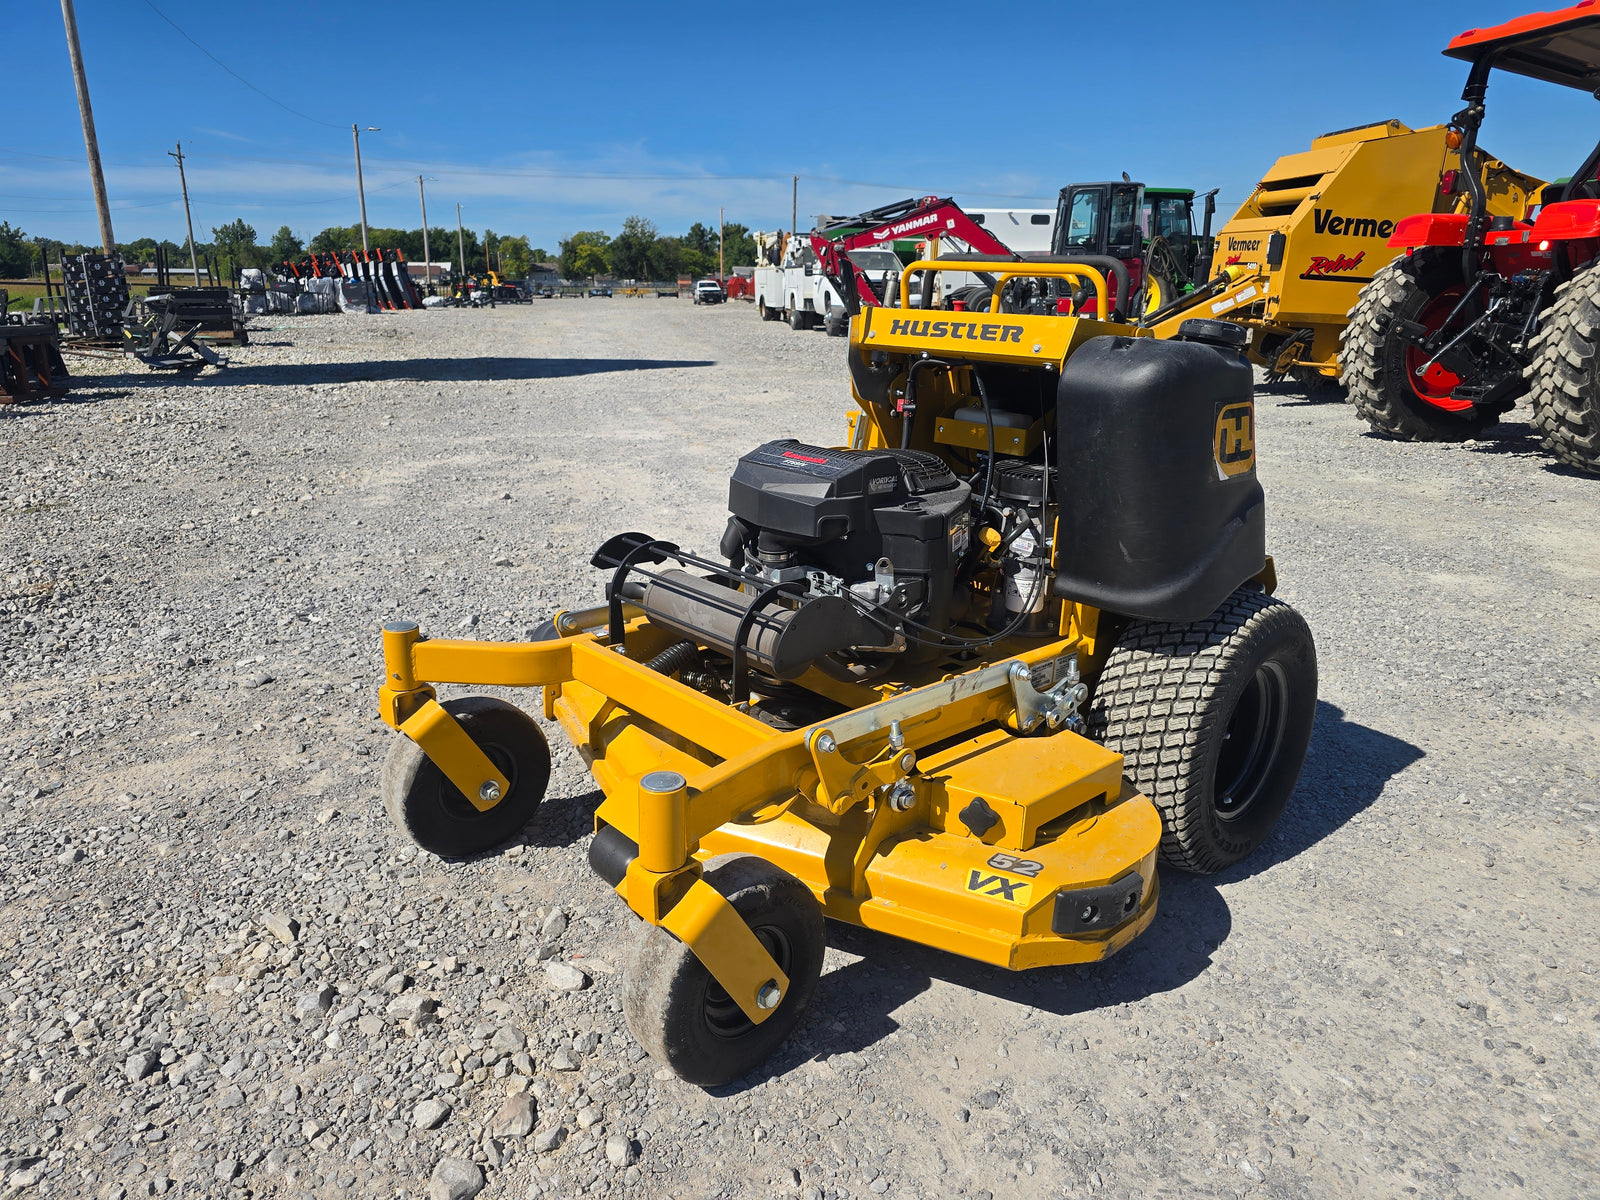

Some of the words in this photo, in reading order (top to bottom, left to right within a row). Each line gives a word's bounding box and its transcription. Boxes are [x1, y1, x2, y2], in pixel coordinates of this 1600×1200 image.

[891, 213, 938, 235] YANMAR
[1314, 208, 1398, 238] Verme
[1228, 236, 1261, 251] Vermeer
[1303, 250, 1366, 277] Rebel
[890, 319, 1024, 343] HUSTLER
[987, 852, 1045, 878] 52
[968, 870, 1029, 901] VX
